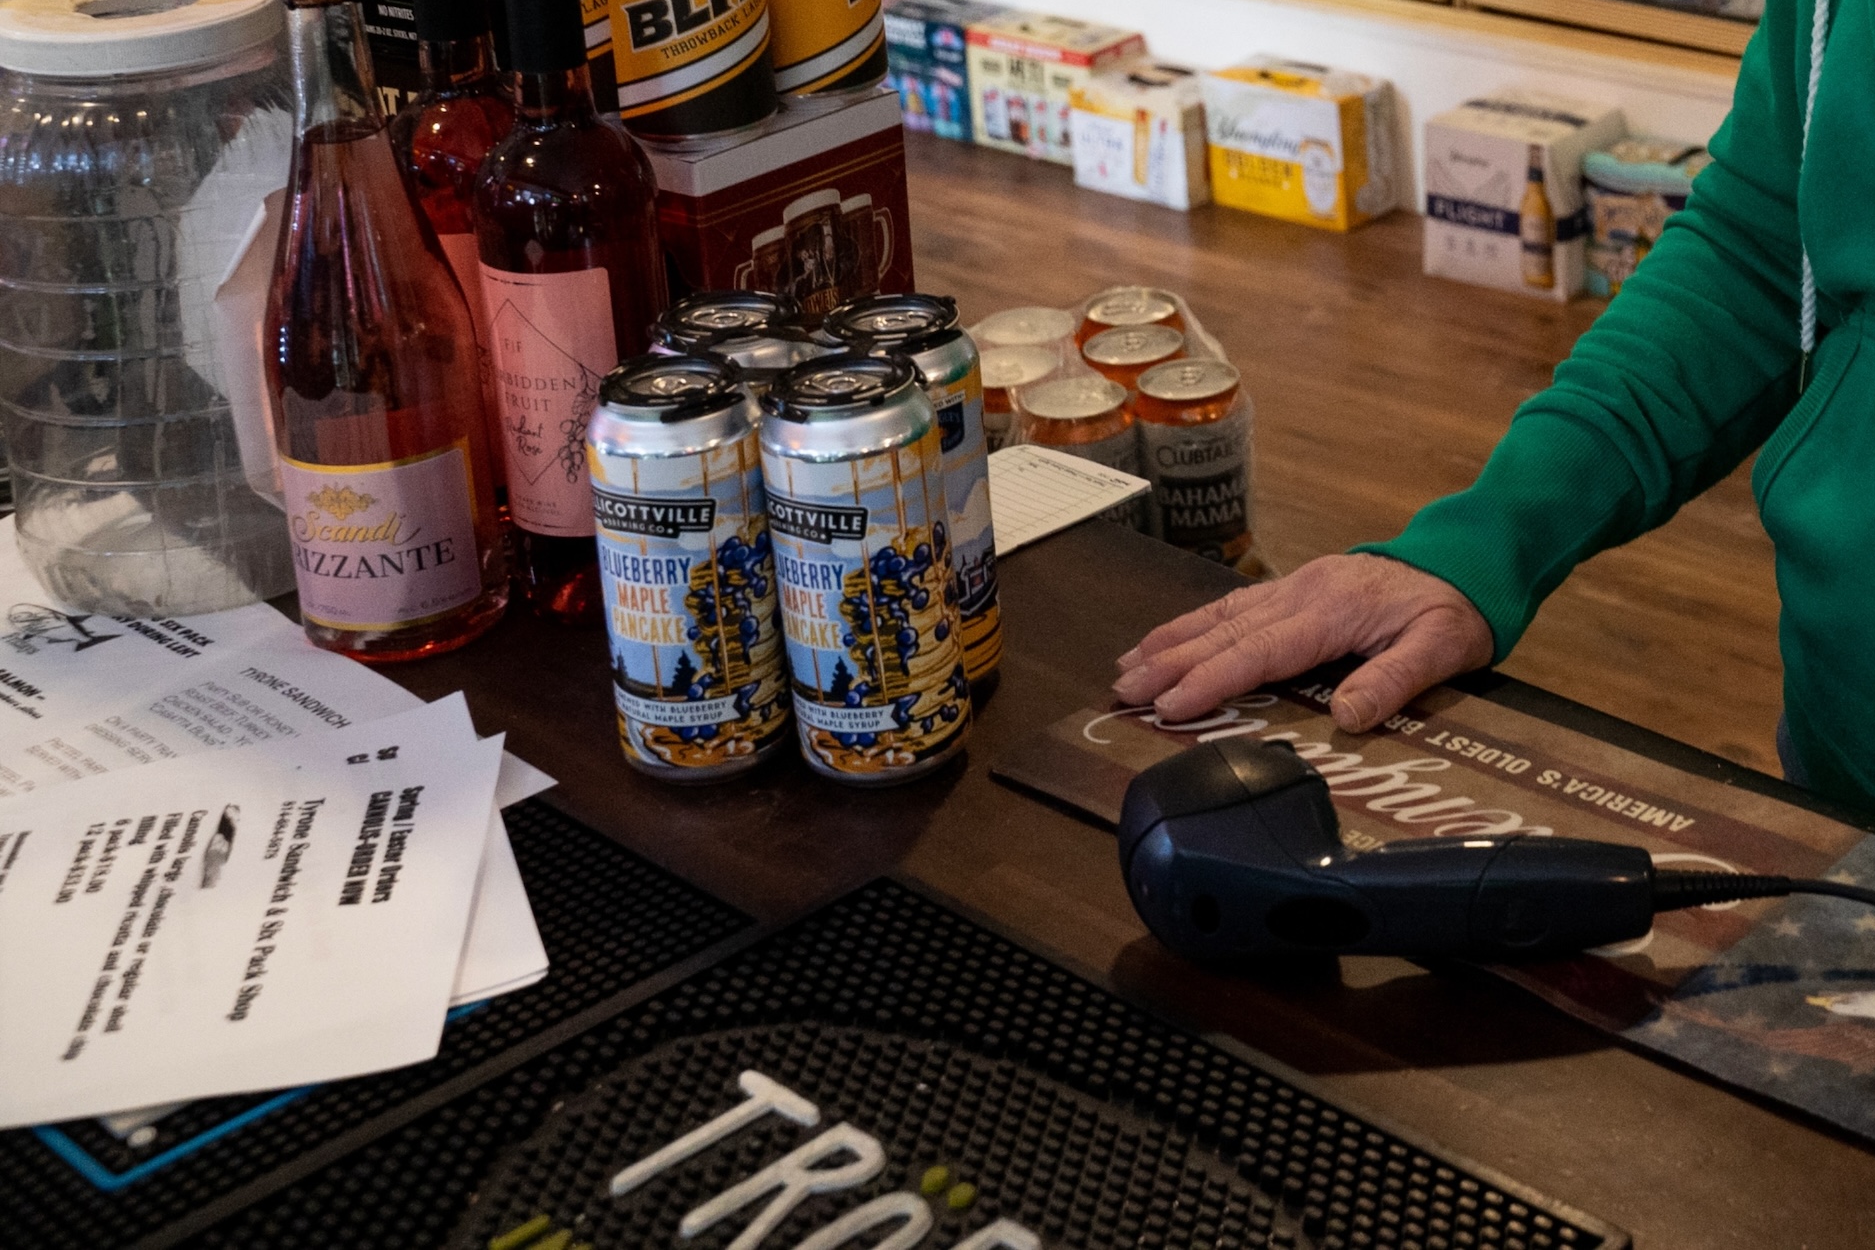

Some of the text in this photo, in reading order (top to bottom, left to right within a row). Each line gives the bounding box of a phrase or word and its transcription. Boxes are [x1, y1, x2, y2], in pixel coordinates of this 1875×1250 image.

[378, 4, 415, 21] NO NITRITES
[660, 15, 741, 60] THROWBACK
[502, 369, 577, 391] BIDDEN
[595, 498, 711, 524] LICOTTVILLE
[1170, 502, 1243, 527] MAMA
[294, 538, 456, 580] RIZZANTE
[602, 545, 692, 586] BLUEBERRY
[777, 556, 844, 591] LUEBERRY
[616, 582, 672, 615] MAPLE
[783, 590, 827, 620] MAPLE
[127, 619, 202, 659] DURING LENT
[160, 619, 215, 648] SIX PACK
[612, 607, 688, 644] PANCAKE
[785, 617, 844, 650] ANCAKE
[240, 666, 352, 730] TYRONE SANDWICH
[644, 699, 727, 716] WITH BLUEBERRY
[808, 703, 885, 720] WITH BLUEBERRY
[654, 711, 686, 723] MAPLE
[689, 711, 724, 723] SYRUP
[816, 716, 881, 730] MAPLE SYRUP
[1424, 727, 1532, 780] OLDEST
[1533, 764, 1697, 834] AMERICA'S
[85, 821, 107, 837] 12
[114, 817, 133, 827] 6
[157, 812, 184, 841] Filled
[176, 809, 209, 855] Cannolis
[148, 842, 169, 865] with
[382, 828, 413, 863] Easter
[163, 855, 193, 883] large
[371, 864, 403, 904] Orders
[127, 865, 159, 909] whipped
[337, 878, 368, 907] NOW
[226, 797, 327, 1023] Tyrone Sandwich & Six Pack Shop
[111, 909, 139, 948] ricotta
[101, 949, 123, 972] and
[135, 940, 152, 955] or
[117, 956, 146, 1001] regular
